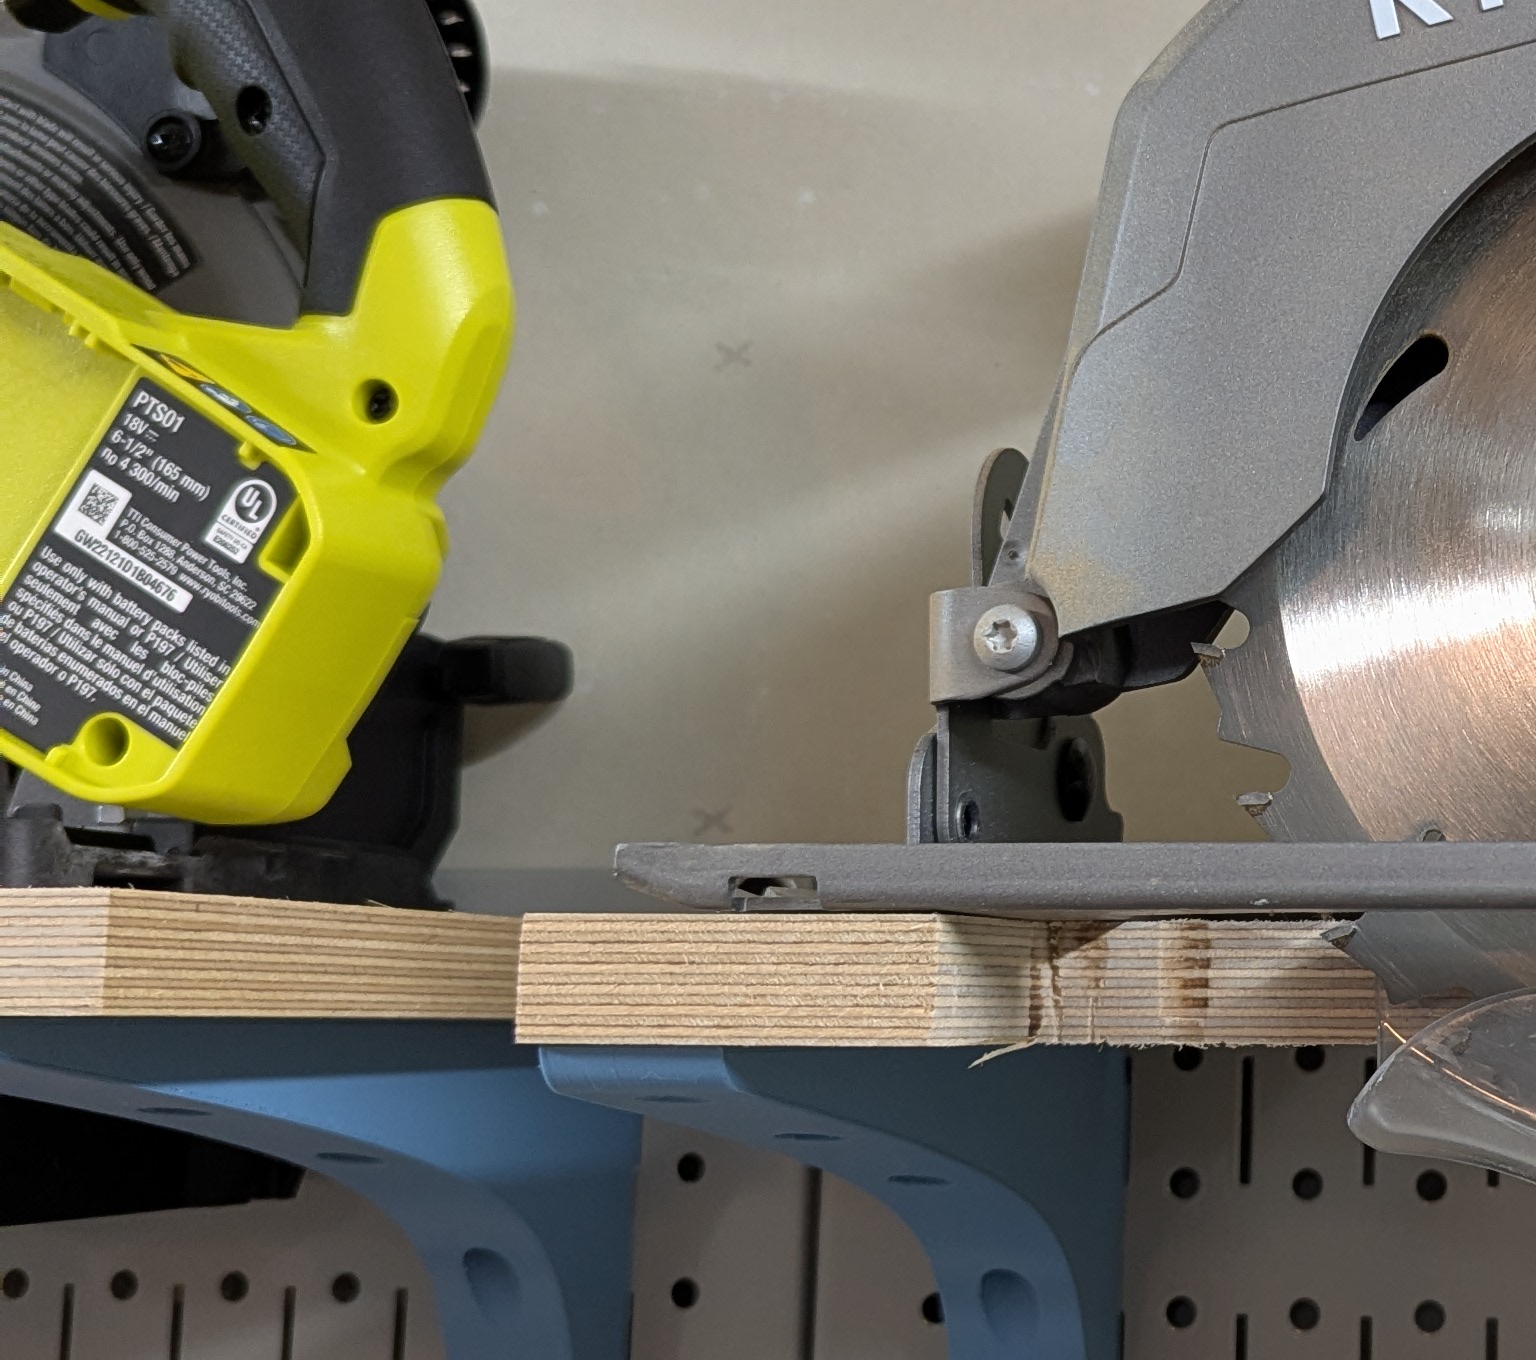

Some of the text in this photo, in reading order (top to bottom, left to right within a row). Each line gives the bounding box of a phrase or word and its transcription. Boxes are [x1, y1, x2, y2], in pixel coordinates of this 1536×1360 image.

[123, 413, 149, 434] 18V
[133, 391, 184, 432] PTS01
[151, 456, 182, 480] (165
[179, 475, 210, 501] mm)
[241, 487, 261, 520] UL
[127, 507, 247, 591] TTI Consumer Power Tools, Inc.
[24, 575, 214, 702] seulement avec les bloc-piles
[32, 562, 86, 600] operator's
[87, 597, 130, 628] manual
[129, 624, 145, 637] or
[144, 632, 175, 655] P197
[183, 656, 223, 688] Utiliser
[40, 546, 231, 676] Use only with battery packs listed in
[7, 601, 24, 615] ou
[22, 609, 52, 632] P197
[58, 632, 97, 662] Utilizar
[120, 674, 142, 692] con
[141, 688, 155, 700] el
[151, 696, 198, 729] paquete
[9, 639, 58, 674] operador
[57, 671, 67, 681] o
[63, 618, 91, 641] dans
[90, 635, 103, 648] le
[102, 644, 144, 674] manuel
[57, 652, 123, 699] enumerados
[122, 694, 138, 709] en
[136, 704, 150, 716] el
